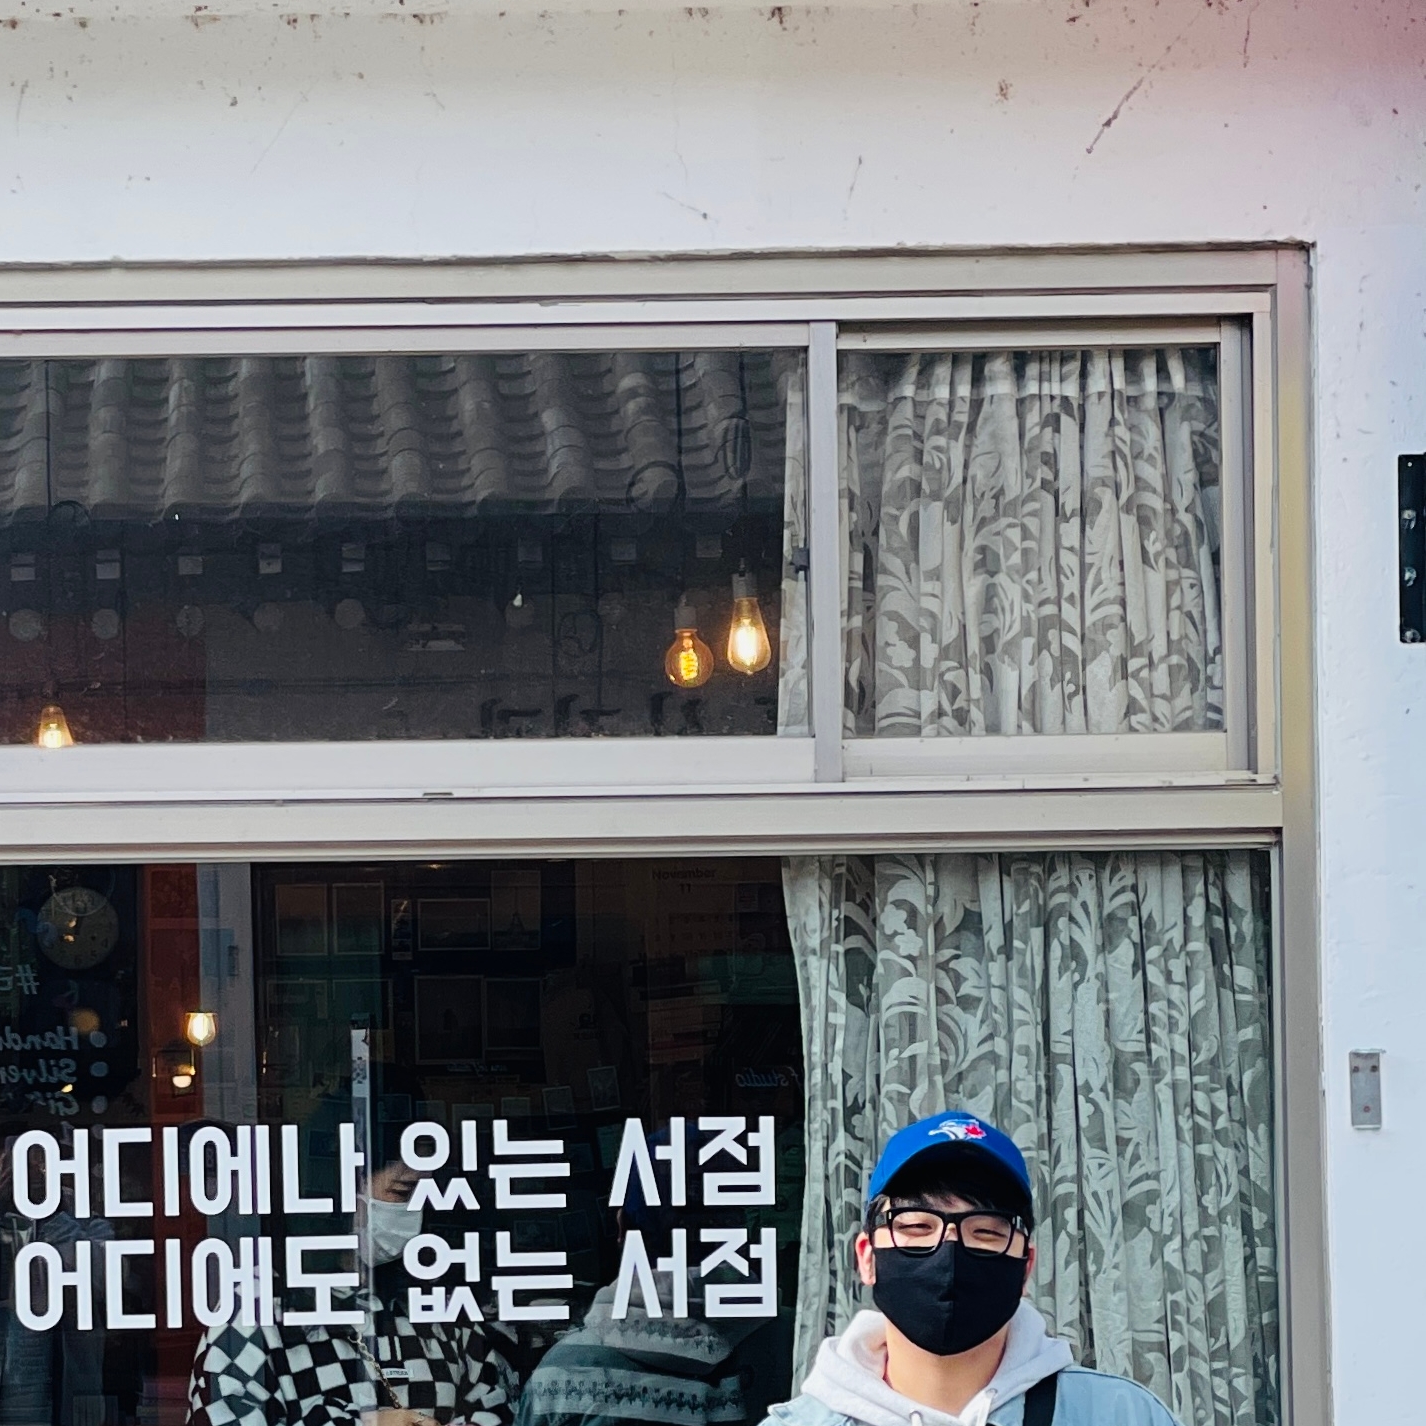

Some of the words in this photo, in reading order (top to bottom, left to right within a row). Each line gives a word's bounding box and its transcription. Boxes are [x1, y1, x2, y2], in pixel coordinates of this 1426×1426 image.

[12, 1122, 366, 1220] 어디에나
[400, 1119, 572, 1212] 있는
[609, 1115, 776, 1207] 서점
[14, 1234, 366, 1332] 어디에도
[403, 1230, 574, 1324] 없는
[611, 1227, 778, 1320] 서점
